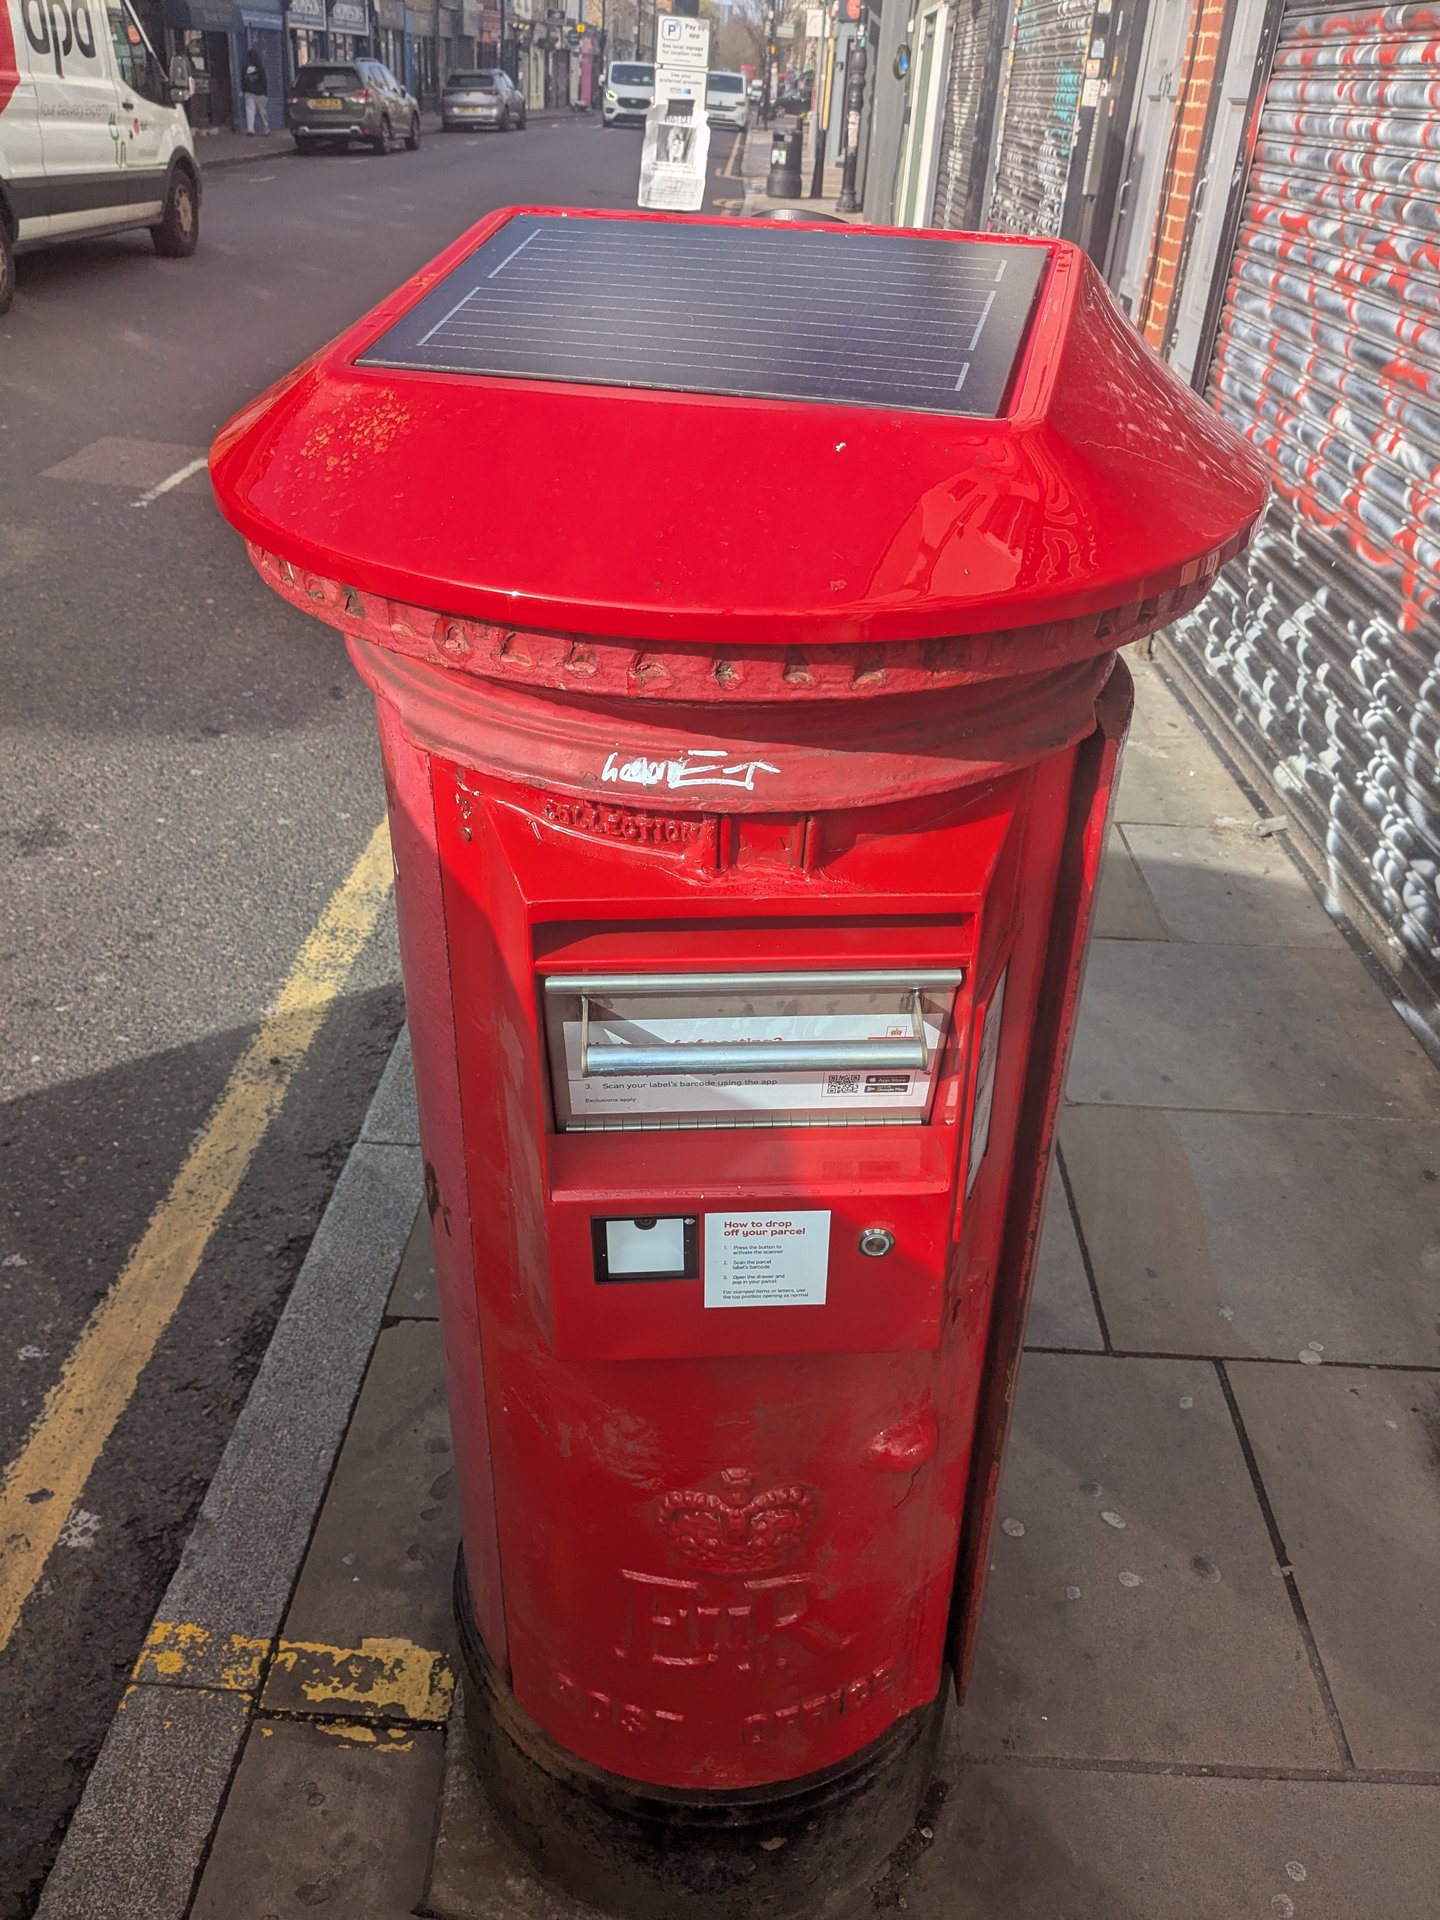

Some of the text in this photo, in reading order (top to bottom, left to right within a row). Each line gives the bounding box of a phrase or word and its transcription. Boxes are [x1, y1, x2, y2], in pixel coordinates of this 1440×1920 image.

[668, 24, 676, 36] P
[626, 1083, 647, 1091] your
[679, 1080, 716, 1088] barcode
[717, 1080, 743, 1088] using
[765, 1220, 792, 1228] drop
[724, 1228, 806, 1238] off your parcel
